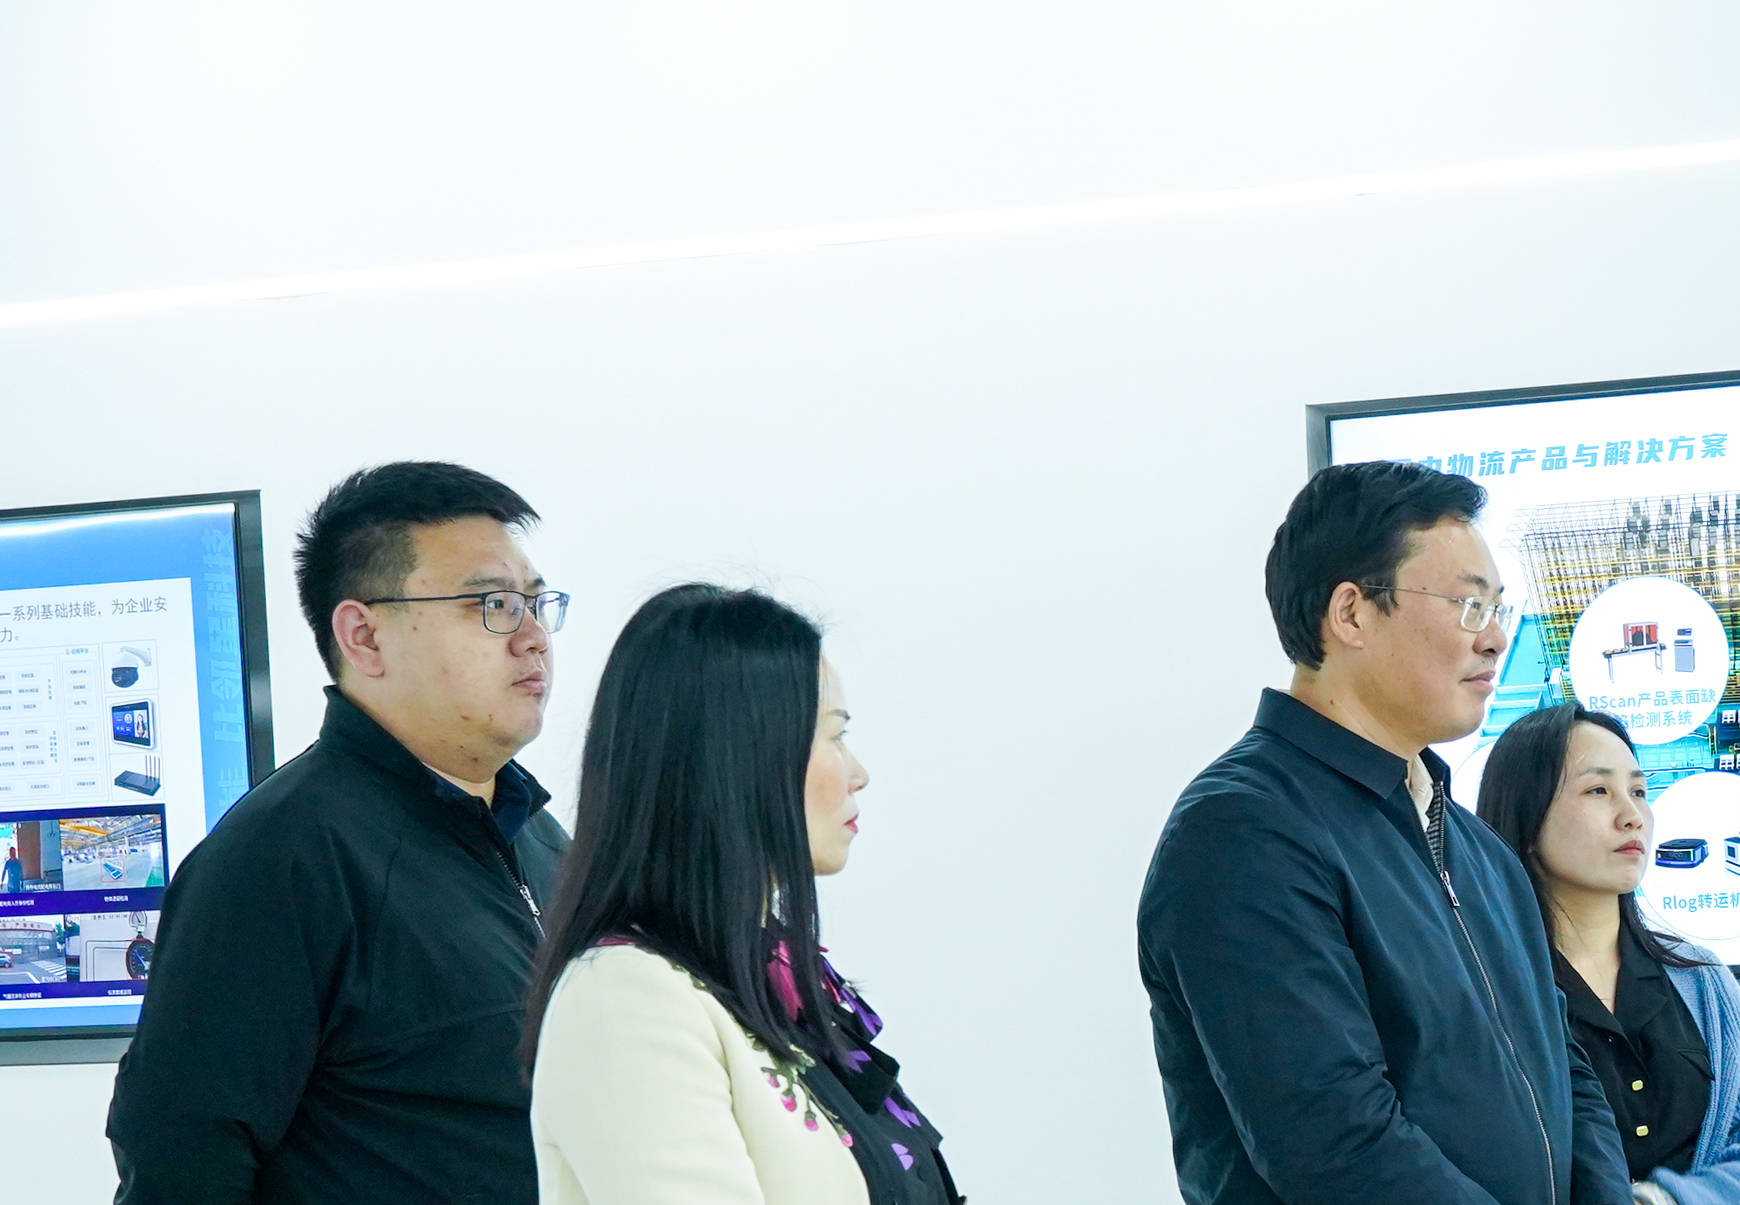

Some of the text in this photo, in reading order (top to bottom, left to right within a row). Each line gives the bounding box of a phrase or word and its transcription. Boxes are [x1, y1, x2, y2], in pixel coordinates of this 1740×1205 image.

[1390, 433, 1728, 477] 物流产品与解决方案
[1589, 688, 1717, 710] RScan产品表面缺
